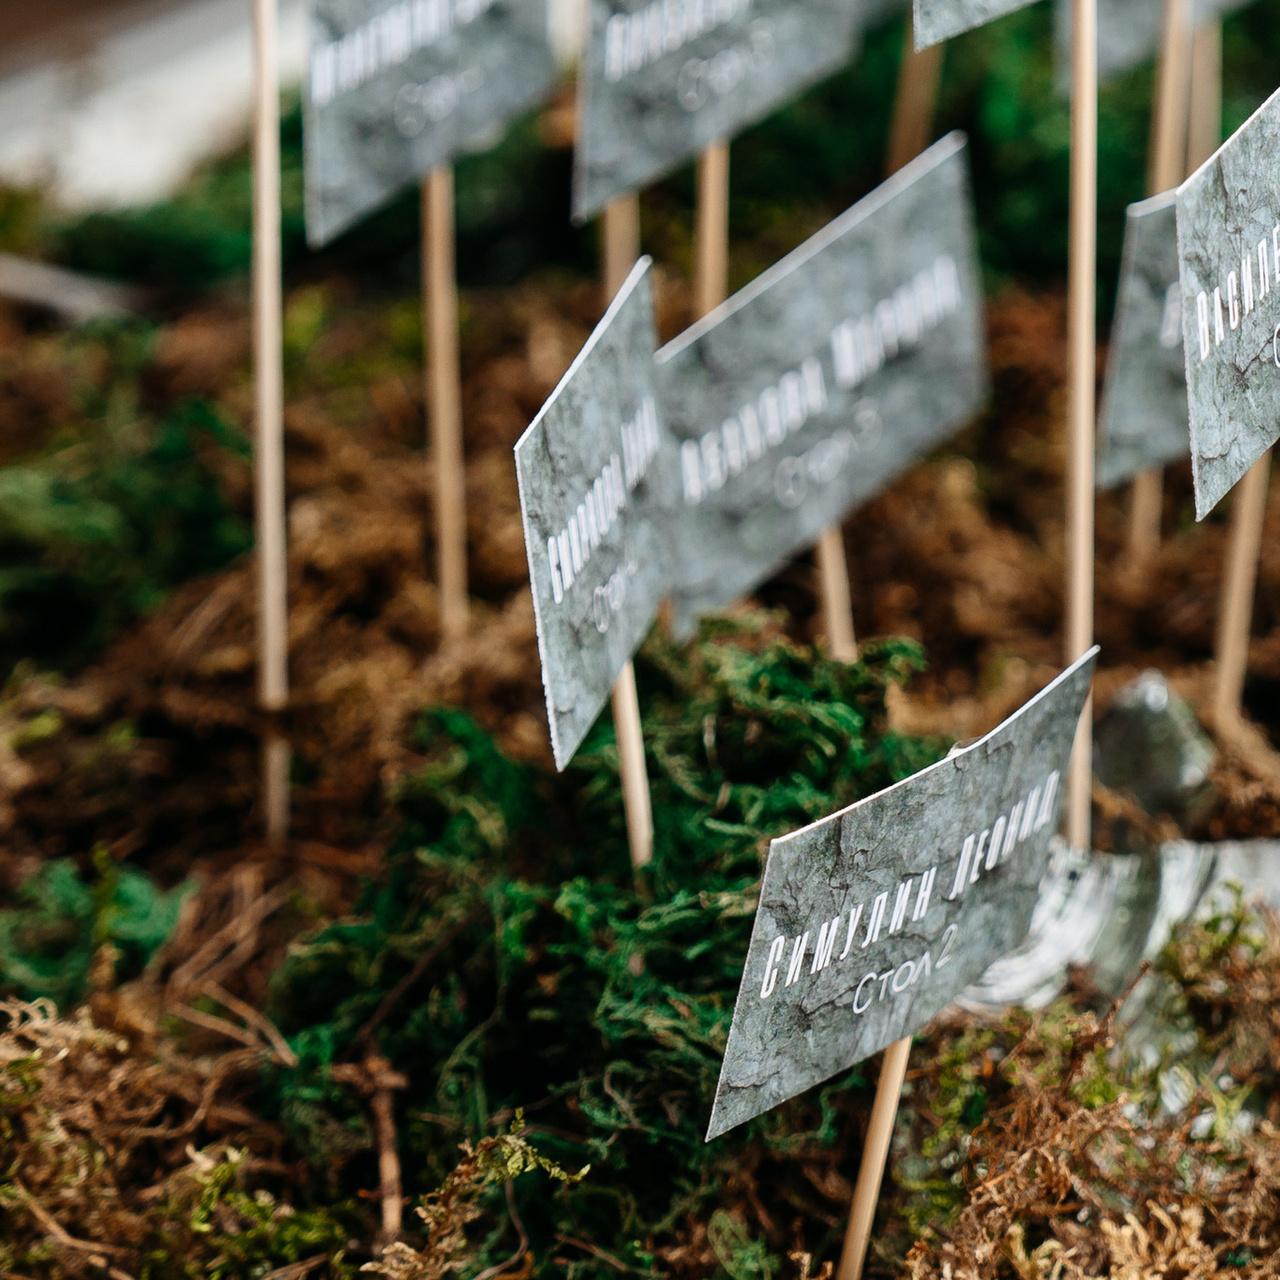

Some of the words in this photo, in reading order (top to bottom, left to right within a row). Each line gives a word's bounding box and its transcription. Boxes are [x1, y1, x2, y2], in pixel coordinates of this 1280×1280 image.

[760, 866, 937, 1000] СИМУЛИН
[949, 770, 1061, 901] ЛЕОНИД
[935, 922, 959, 968] 2
